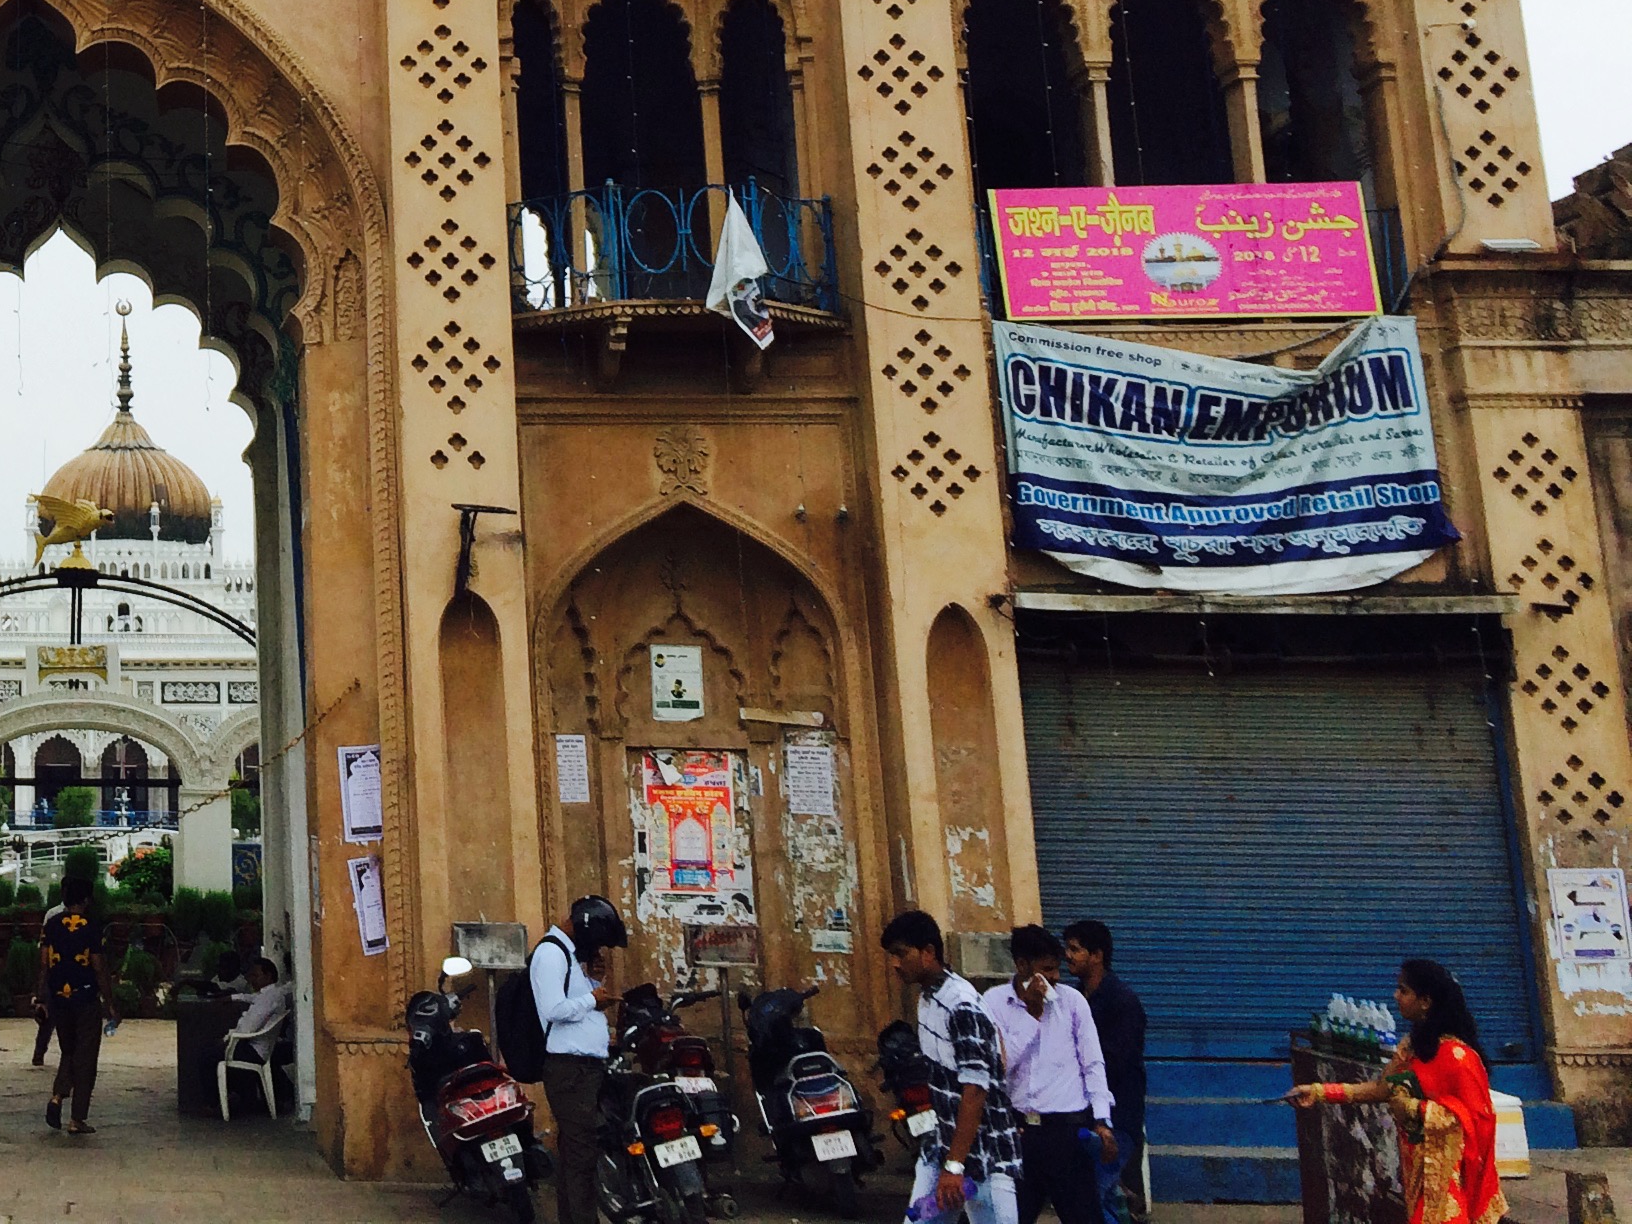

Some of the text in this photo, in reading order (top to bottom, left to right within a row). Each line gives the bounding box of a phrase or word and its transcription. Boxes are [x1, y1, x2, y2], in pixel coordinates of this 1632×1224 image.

[1282, 202, 1359, 240] جشن
[1008, 331, 1162, 368] Commission free shop
[1011, 360, 1184, 439] CHIKAN
[1359, 428, 1382, 442] and
[1017, 482, 1167, 523] Government
[1298, 485, 1375, 517] Retail
[1374, 481, 1440, 508] Shop
